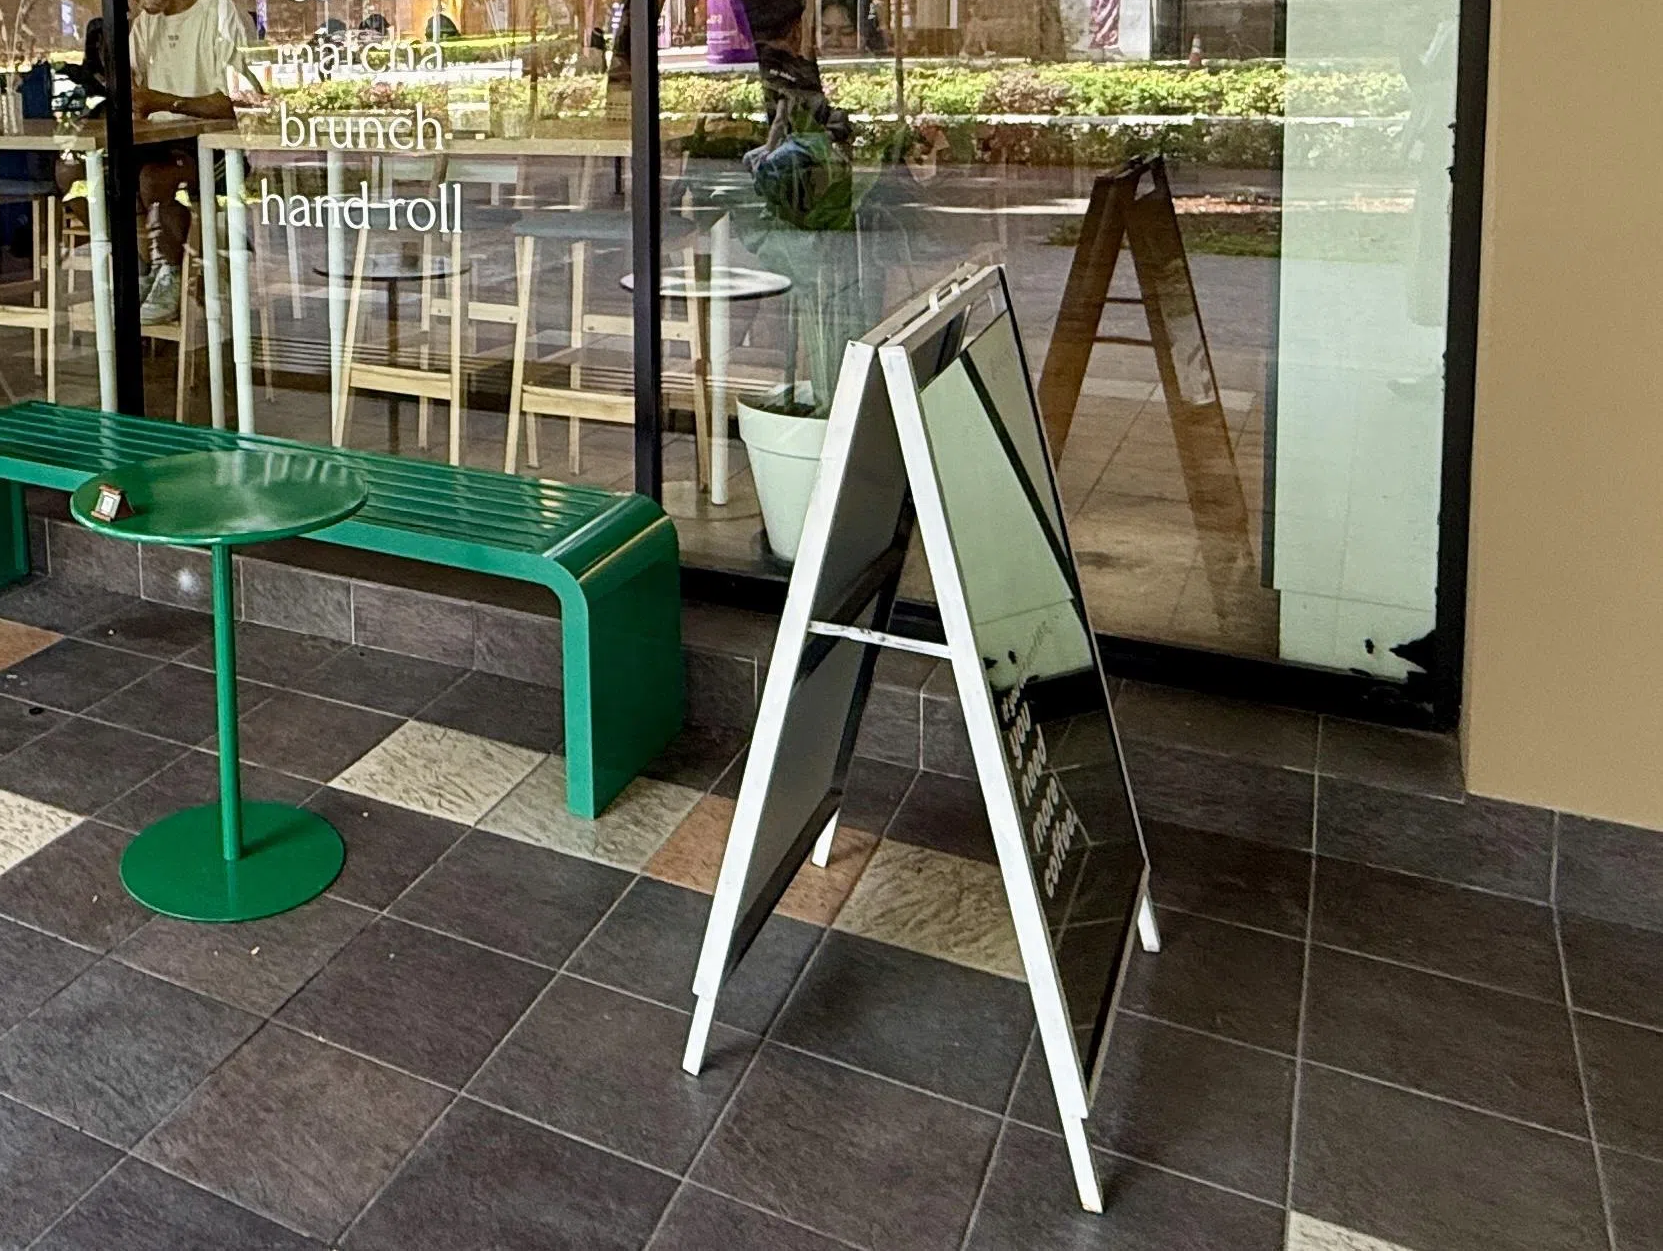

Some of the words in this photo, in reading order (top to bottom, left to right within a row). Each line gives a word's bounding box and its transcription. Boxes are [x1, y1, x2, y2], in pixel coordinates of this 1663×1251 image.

[277, 25, 445, 74] matcha
[280, 101, 444, 150] brunch
[261, 177, 370, 230] hand
[388, 182, 462, 234] roll
[1009, 700, 1031, 770] you
[1021, 723, 1046, 807] need
[1033, 776, 1059, 853] more
